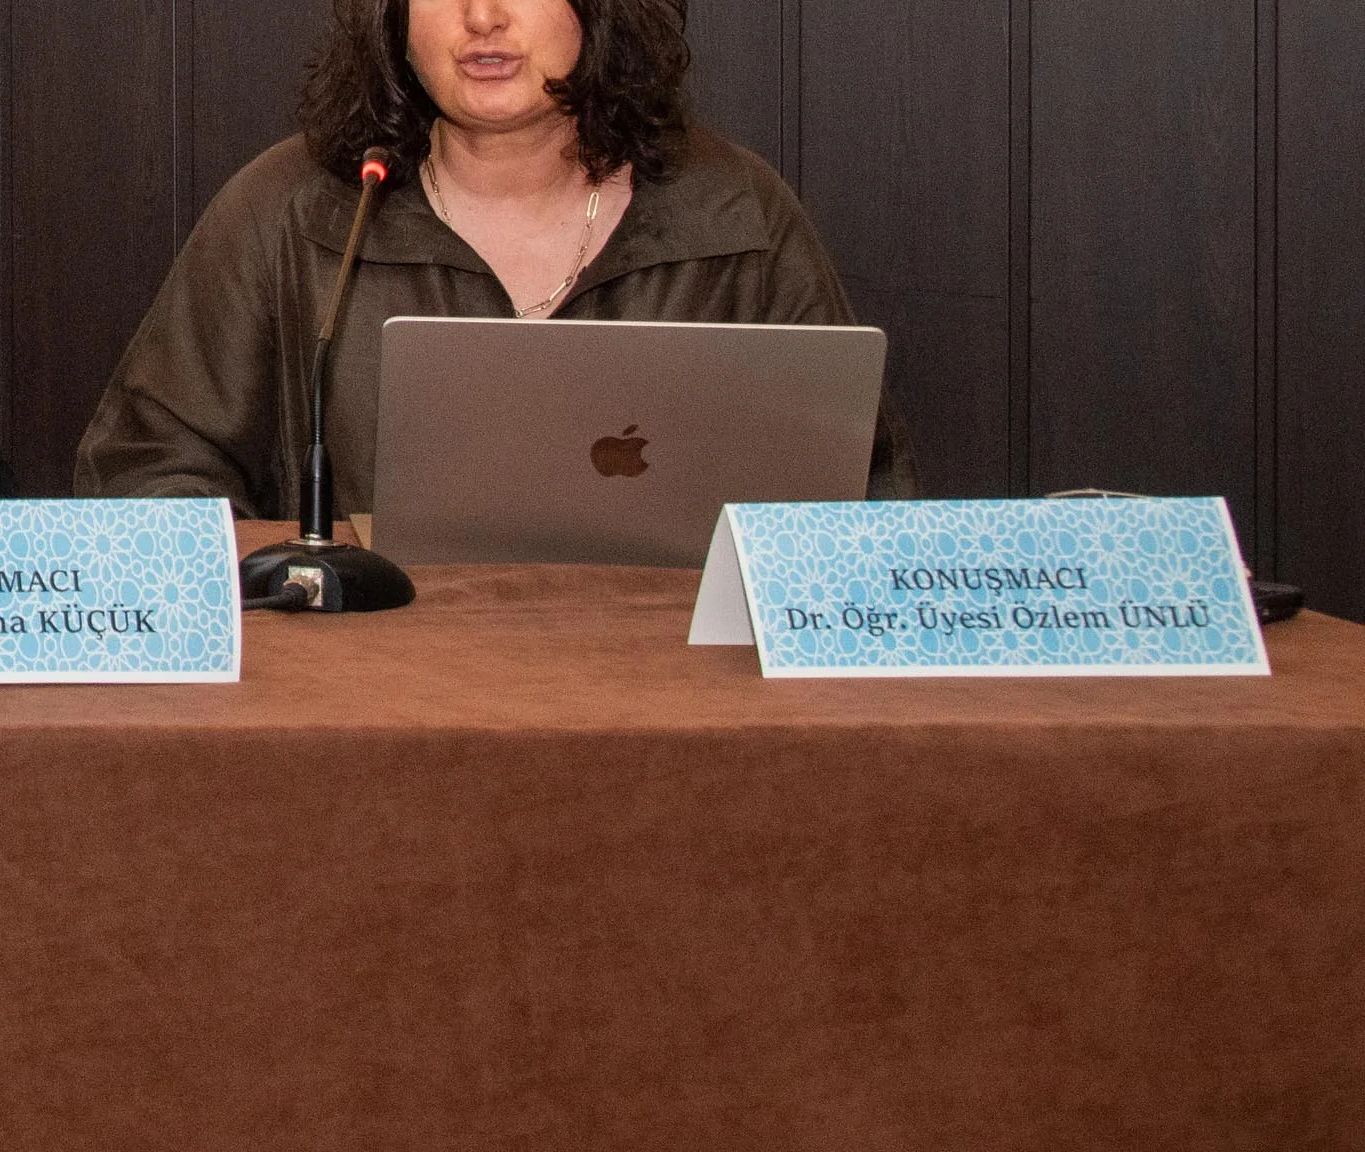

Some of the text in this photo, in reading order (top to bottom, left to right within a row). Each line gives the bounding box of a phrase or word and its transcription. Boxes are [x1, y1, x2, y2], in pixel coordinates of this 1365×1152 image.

[890, 567, 1087, 597] KONUŞMACI
[38, 603, 157, 639] KÜÇÜK
[786, 599, 1211, 636] Dr. Öğr. Üyesi Özlem ÜNLÜ
